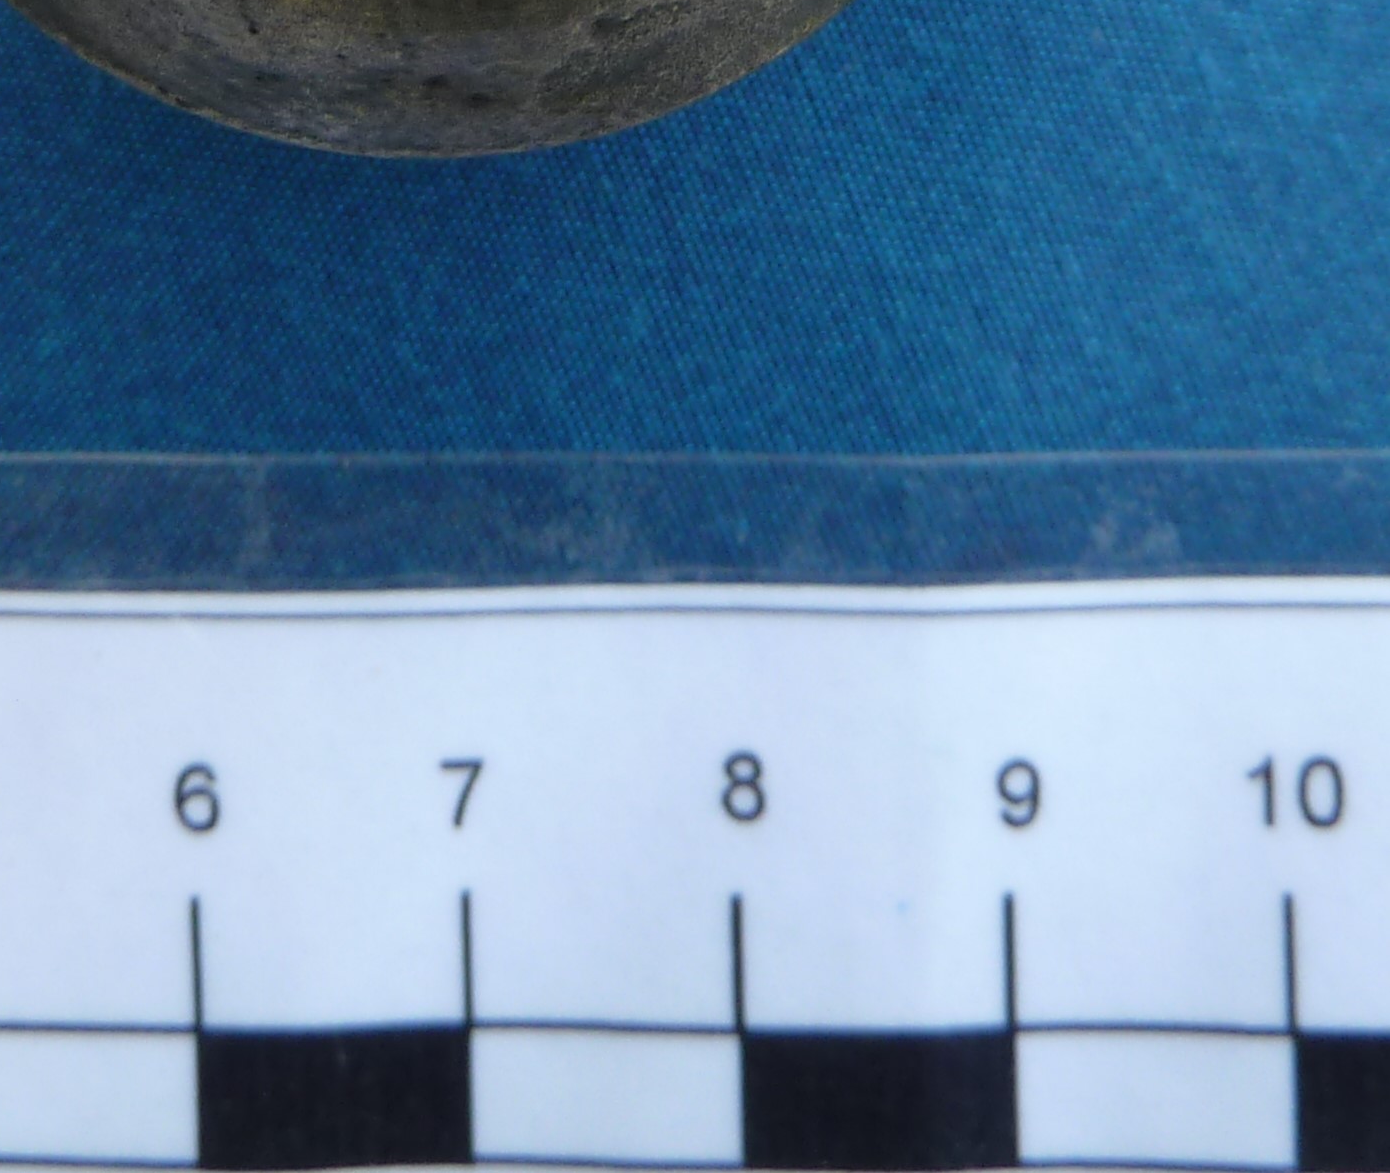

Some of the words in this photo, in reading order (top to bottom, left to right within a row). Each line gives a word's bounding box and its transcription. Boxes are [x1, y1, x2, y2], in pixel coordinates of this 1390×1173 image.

[174, 764, 219, 833] 6
[442, 761, 482, 826] 7
[722, 752, 765, 822] 8
[998, 761, 1040, 828] 9
[1251, 757, 1343, 828] 10
